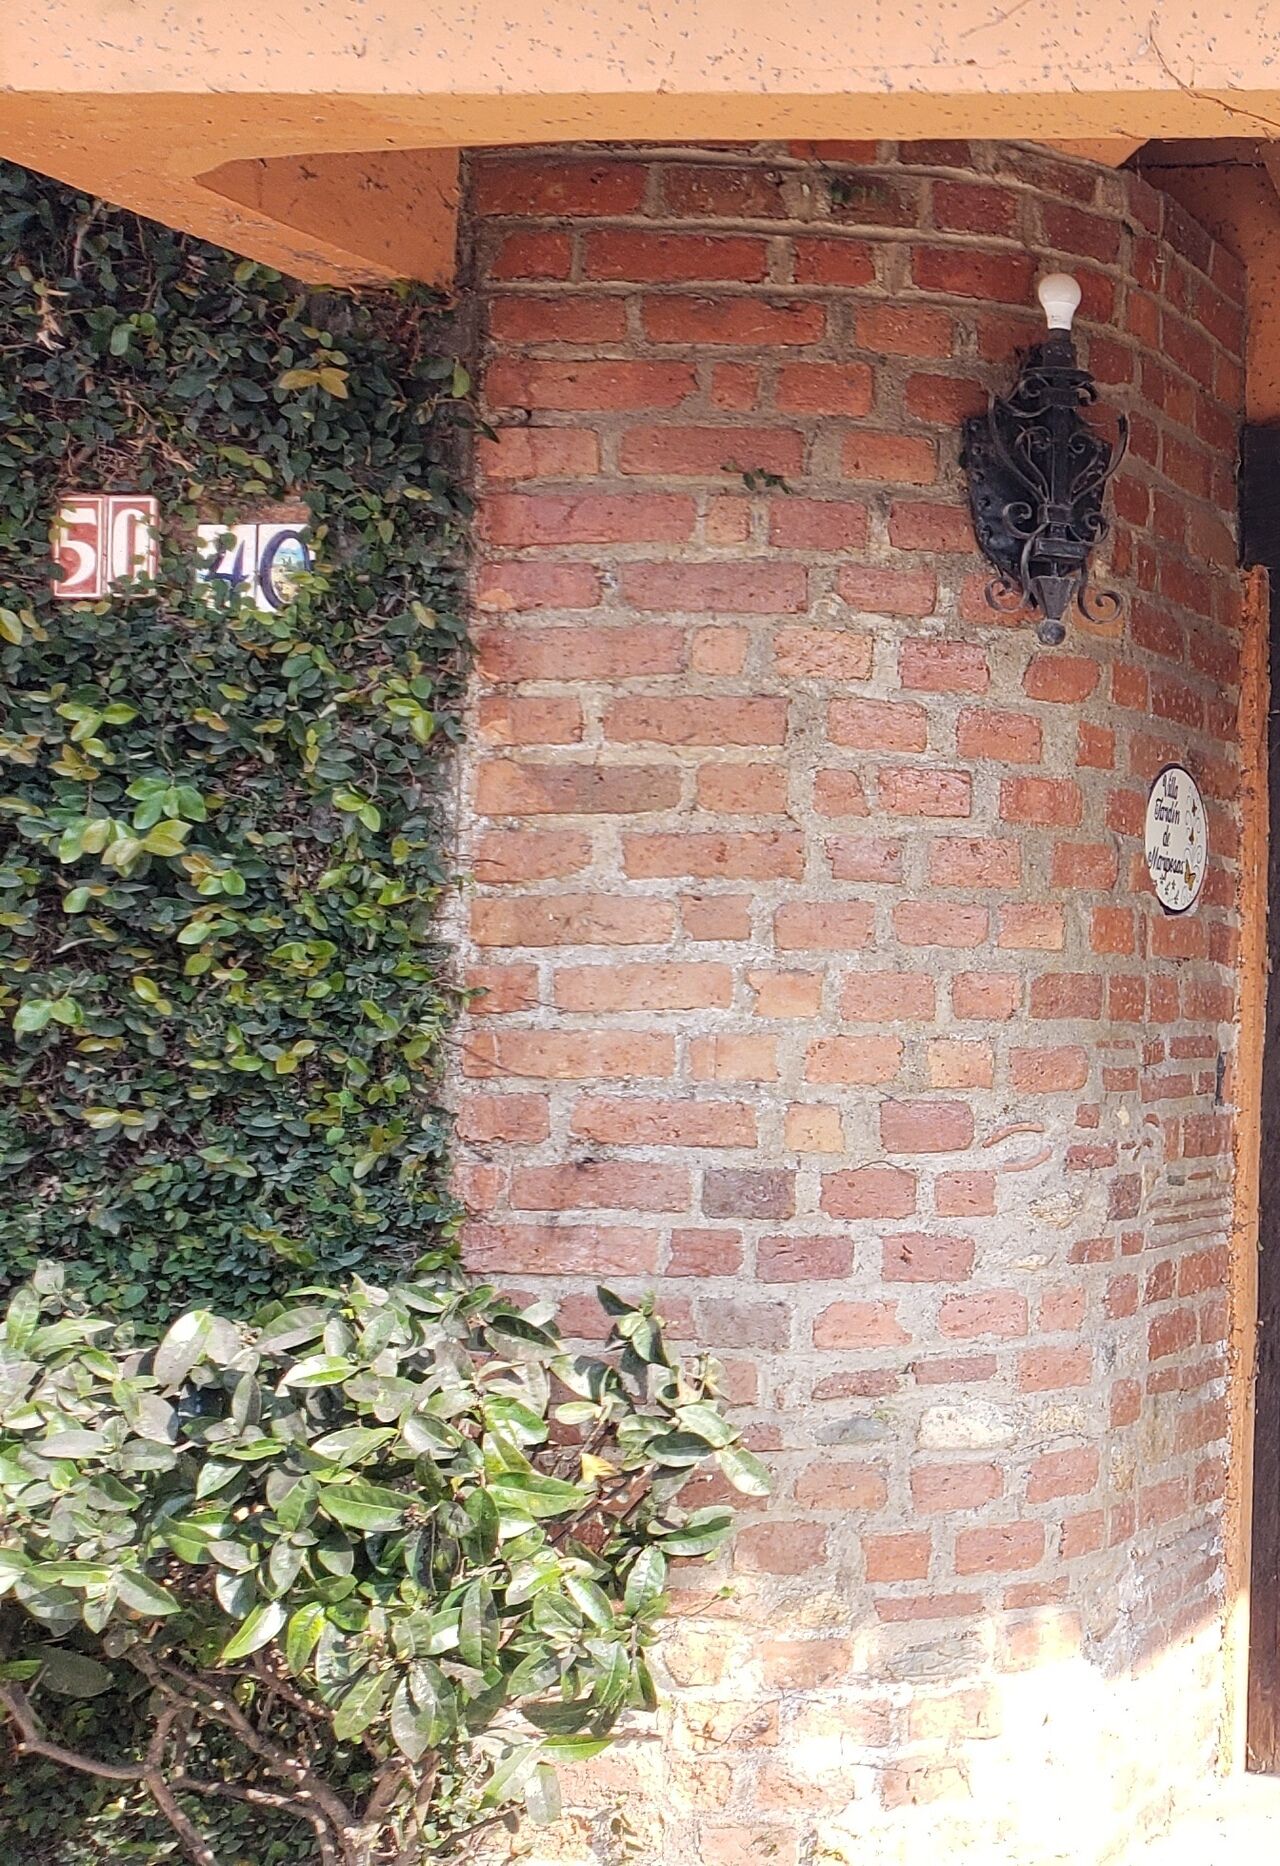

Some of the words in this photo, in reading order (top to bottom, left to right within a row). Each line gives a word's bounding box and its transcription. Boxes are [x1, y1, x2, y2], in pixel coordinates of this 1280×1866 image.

[58, 507, 152, 590] 50
[198, 529, 311, 610] 40
[1162, 772, 1178, 799] Villa
[1162, 824, 1171, 847] de
[1148, 846, 1185, 880] Mariposas
